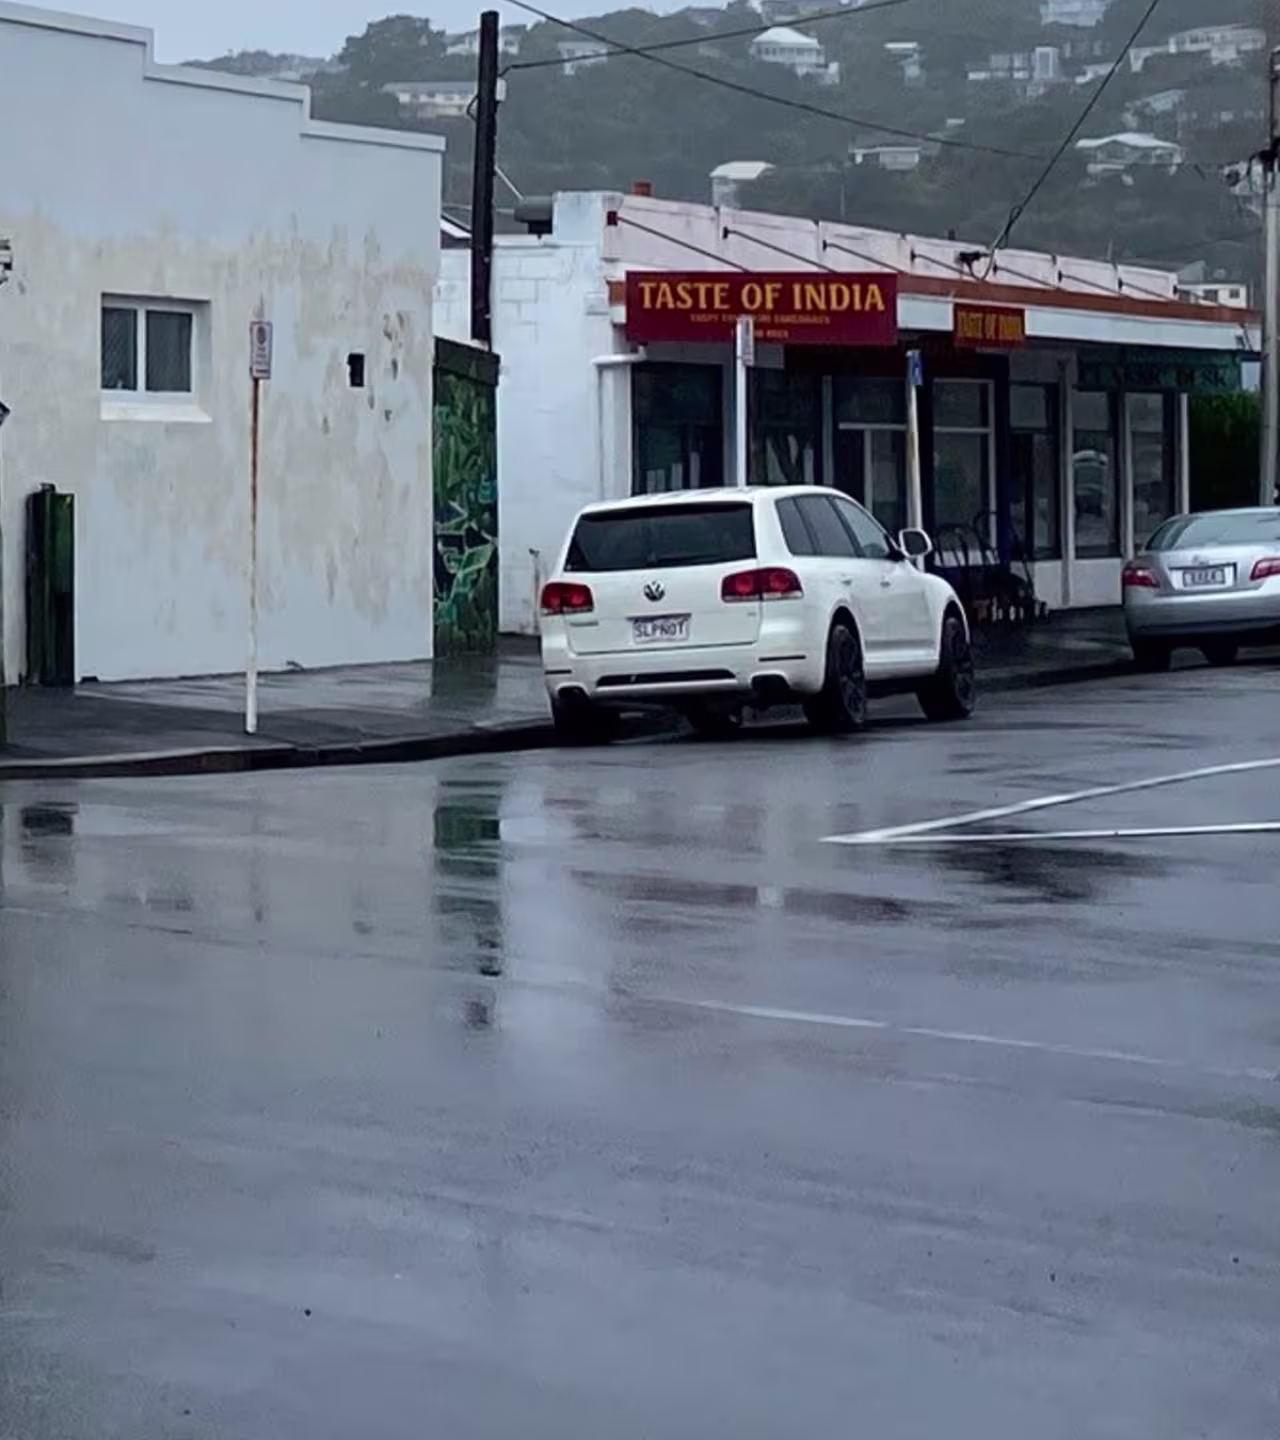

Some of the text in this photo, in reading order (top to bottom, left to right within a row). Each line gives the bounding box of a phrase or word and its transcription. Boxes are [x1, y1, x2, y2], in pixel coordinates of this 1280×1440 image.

[638, 281, 885, 312] TASTE OF INDIA
